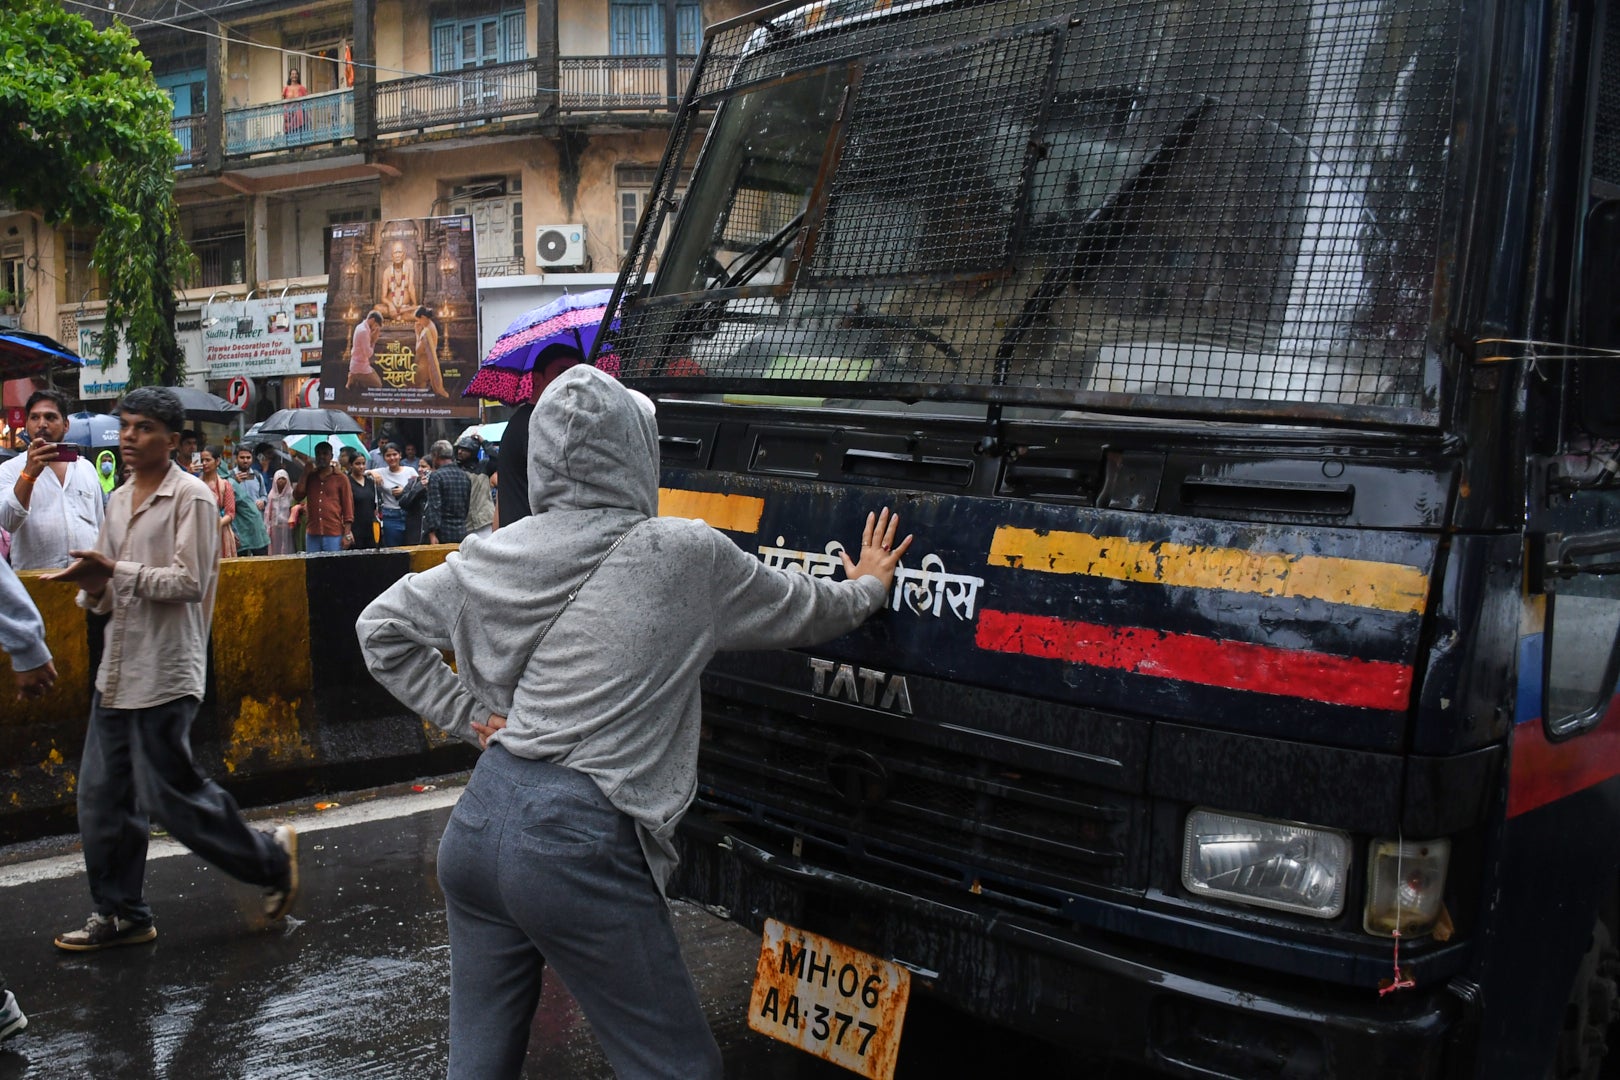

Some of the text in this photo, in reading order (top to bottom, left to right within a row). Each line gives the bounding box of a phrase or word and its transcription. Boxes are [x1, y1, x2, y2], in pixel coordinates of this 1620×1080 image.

[207, 347, 291, 361] All Occasions & Festivals
[208, 340, 283, 352] Flower Decoration for
[374, 346, 415, 372] स्वामी
[383, 363, 418, 388] समर्थ
[884, 553, 985, 622] ोलीस
[808, 657, 914, 715] TATA
